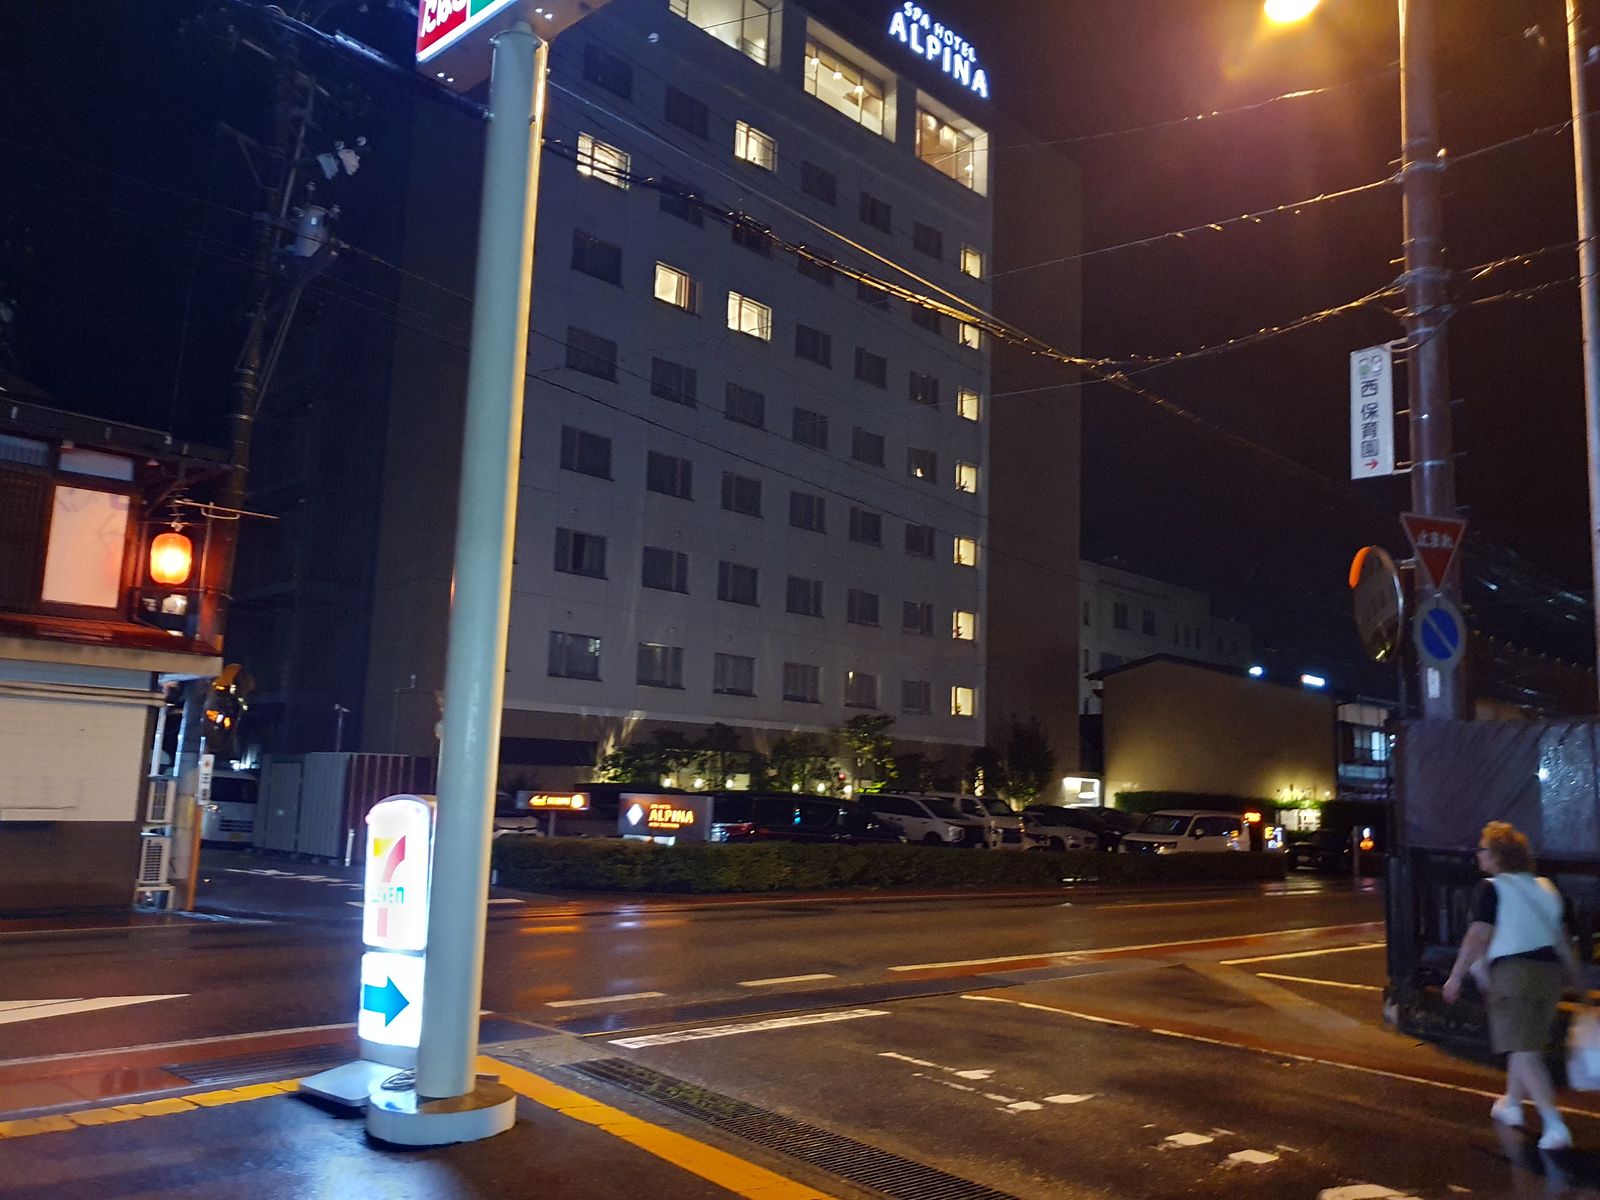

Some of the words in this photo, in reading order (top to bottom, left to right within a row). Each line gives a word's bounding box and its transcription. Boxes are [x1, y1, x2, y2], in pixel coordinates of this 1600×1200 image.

[888, 11, 988, 98] ALPINA
[903, 1, 931, 30] SPA
[933, 22, 977, 63] HOTEL
[648, 808, 694, 824] ALPINA
